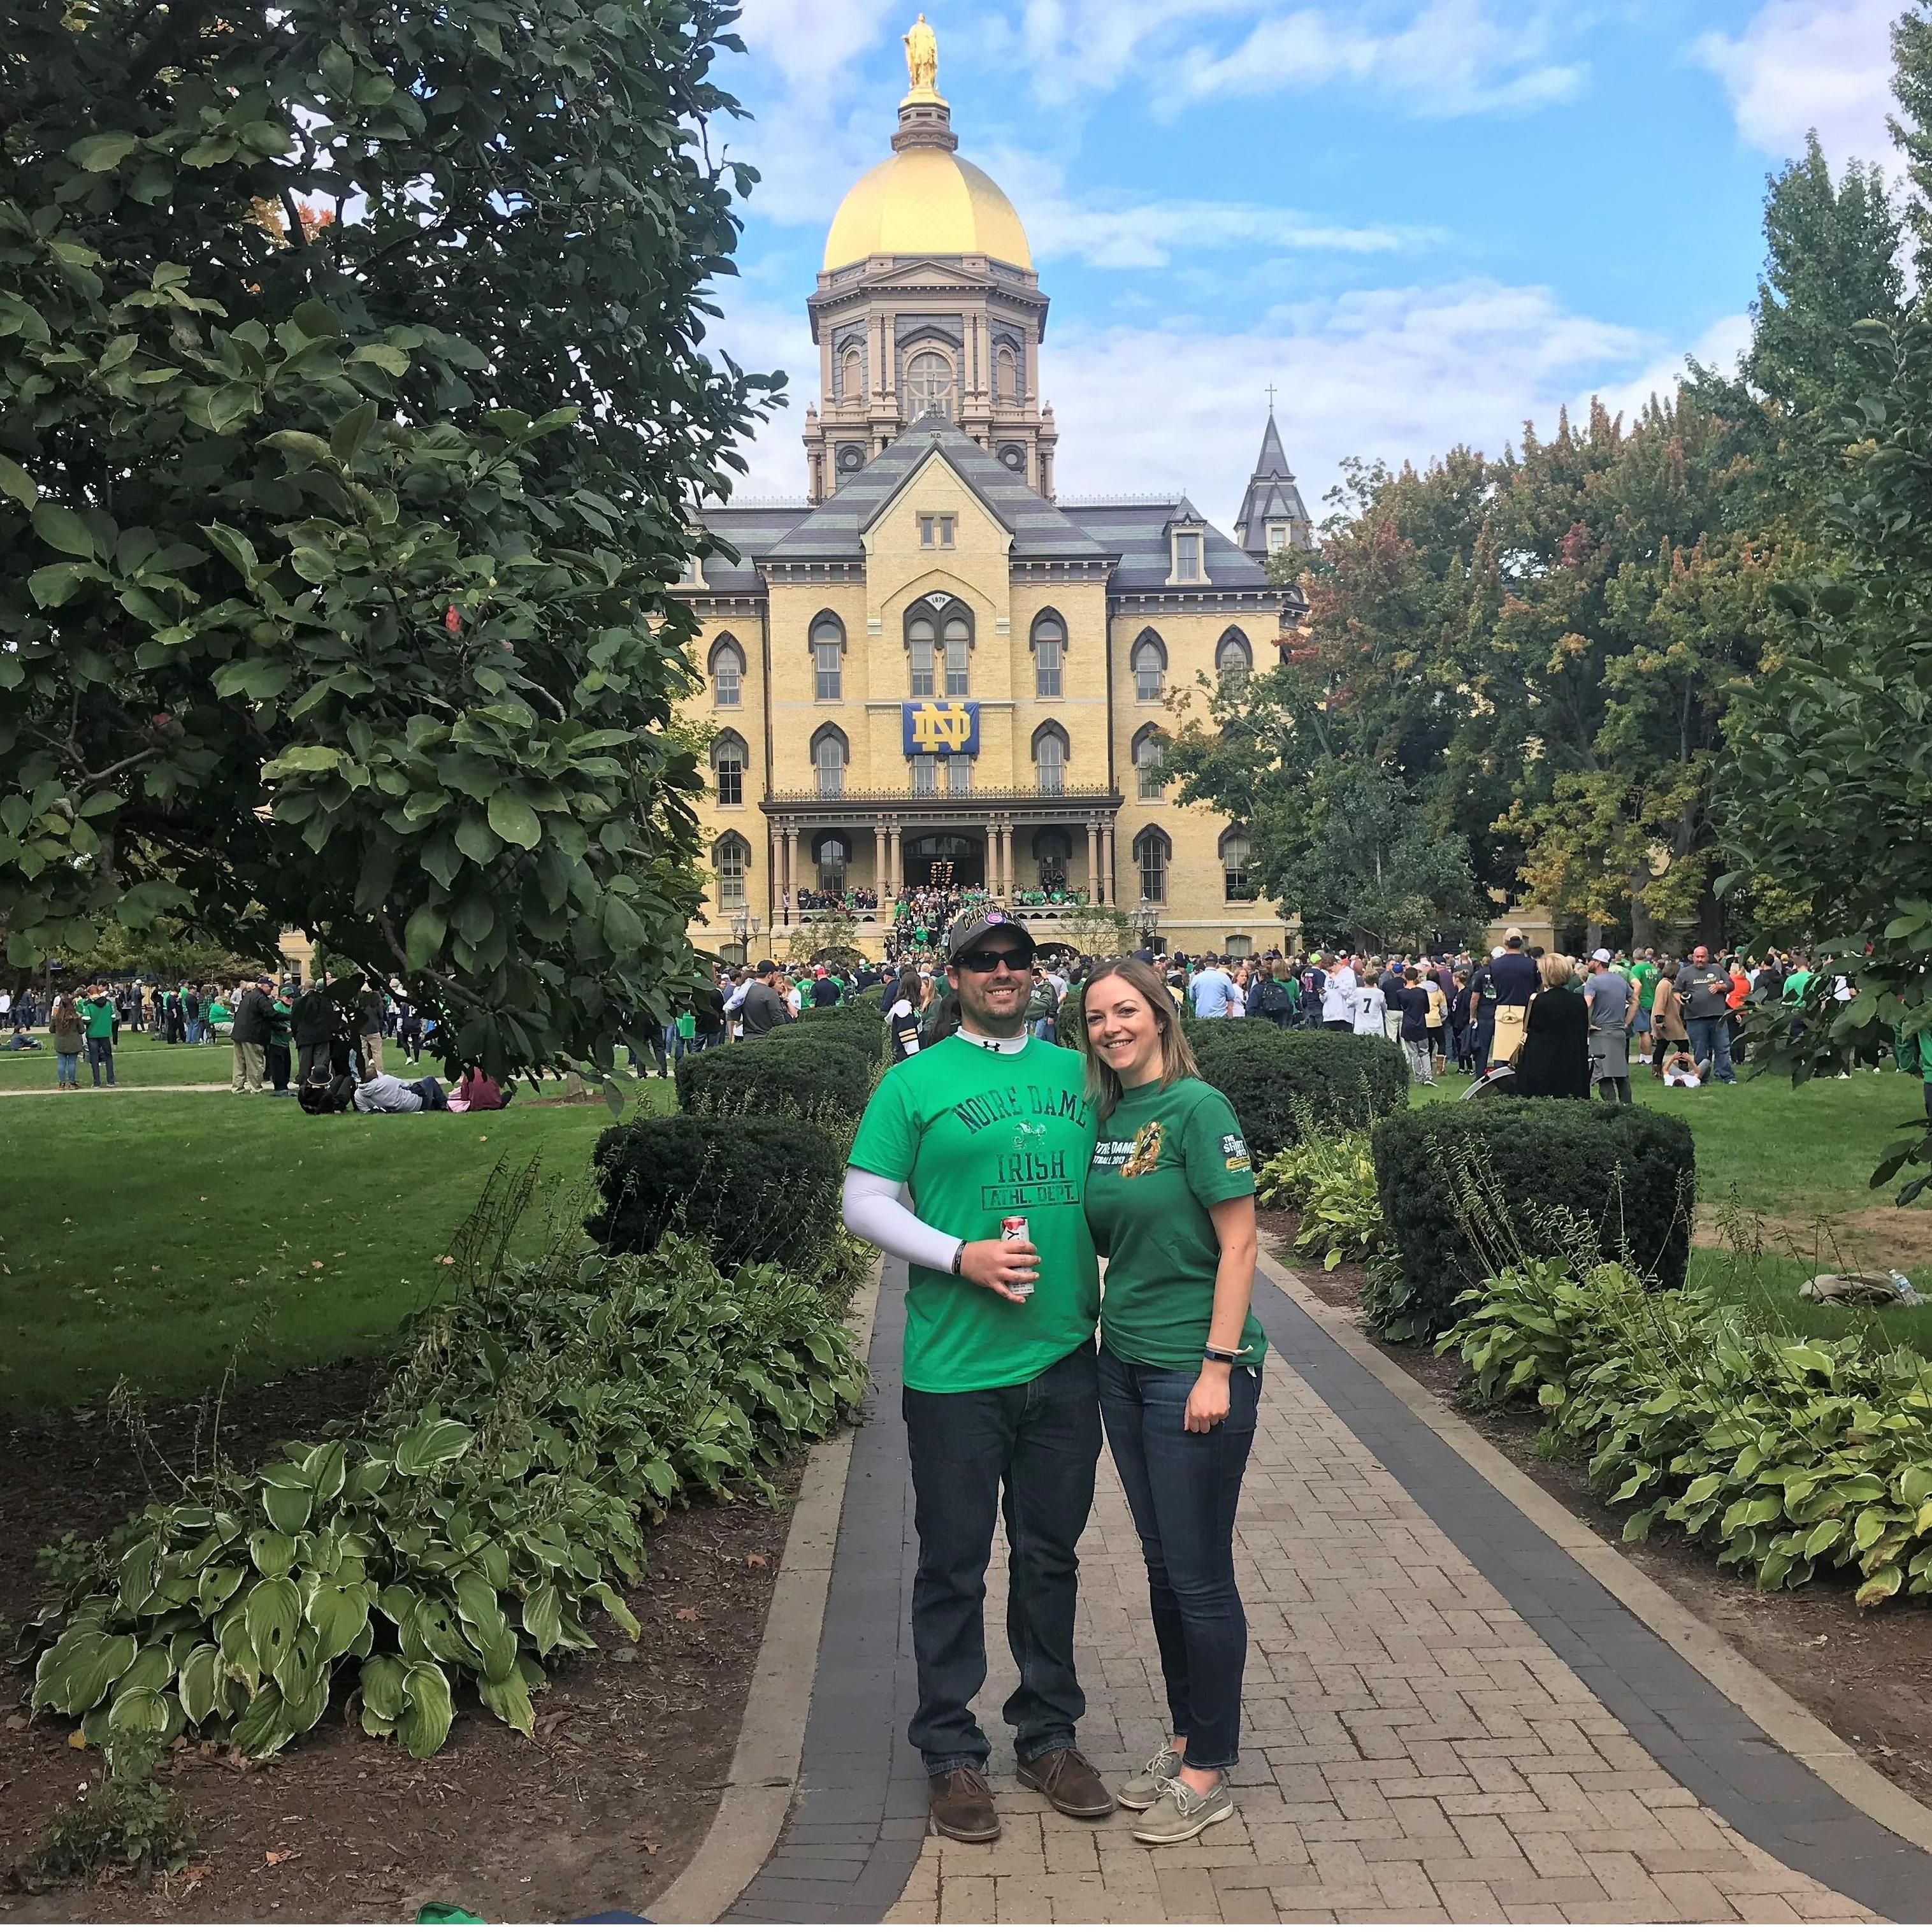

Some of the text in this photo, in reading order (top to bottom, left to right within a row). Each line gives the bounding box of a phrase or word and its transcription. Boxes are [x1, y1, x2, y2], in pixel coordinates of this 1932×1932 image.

[1364, 998, 1372, 1013] 7
[951, 1085, 1091, 1135] NOTRE DAME
[1223, 1134, 1236, 1143] THE
[1111, 1141, 1137, 1154] DAME
[1223, 1140, 1244, 1153] SHIRT
[997, 1150, 1065, 1183] IRISH
[990, 1184, 1074, 1205] ATHL. DEPT.
